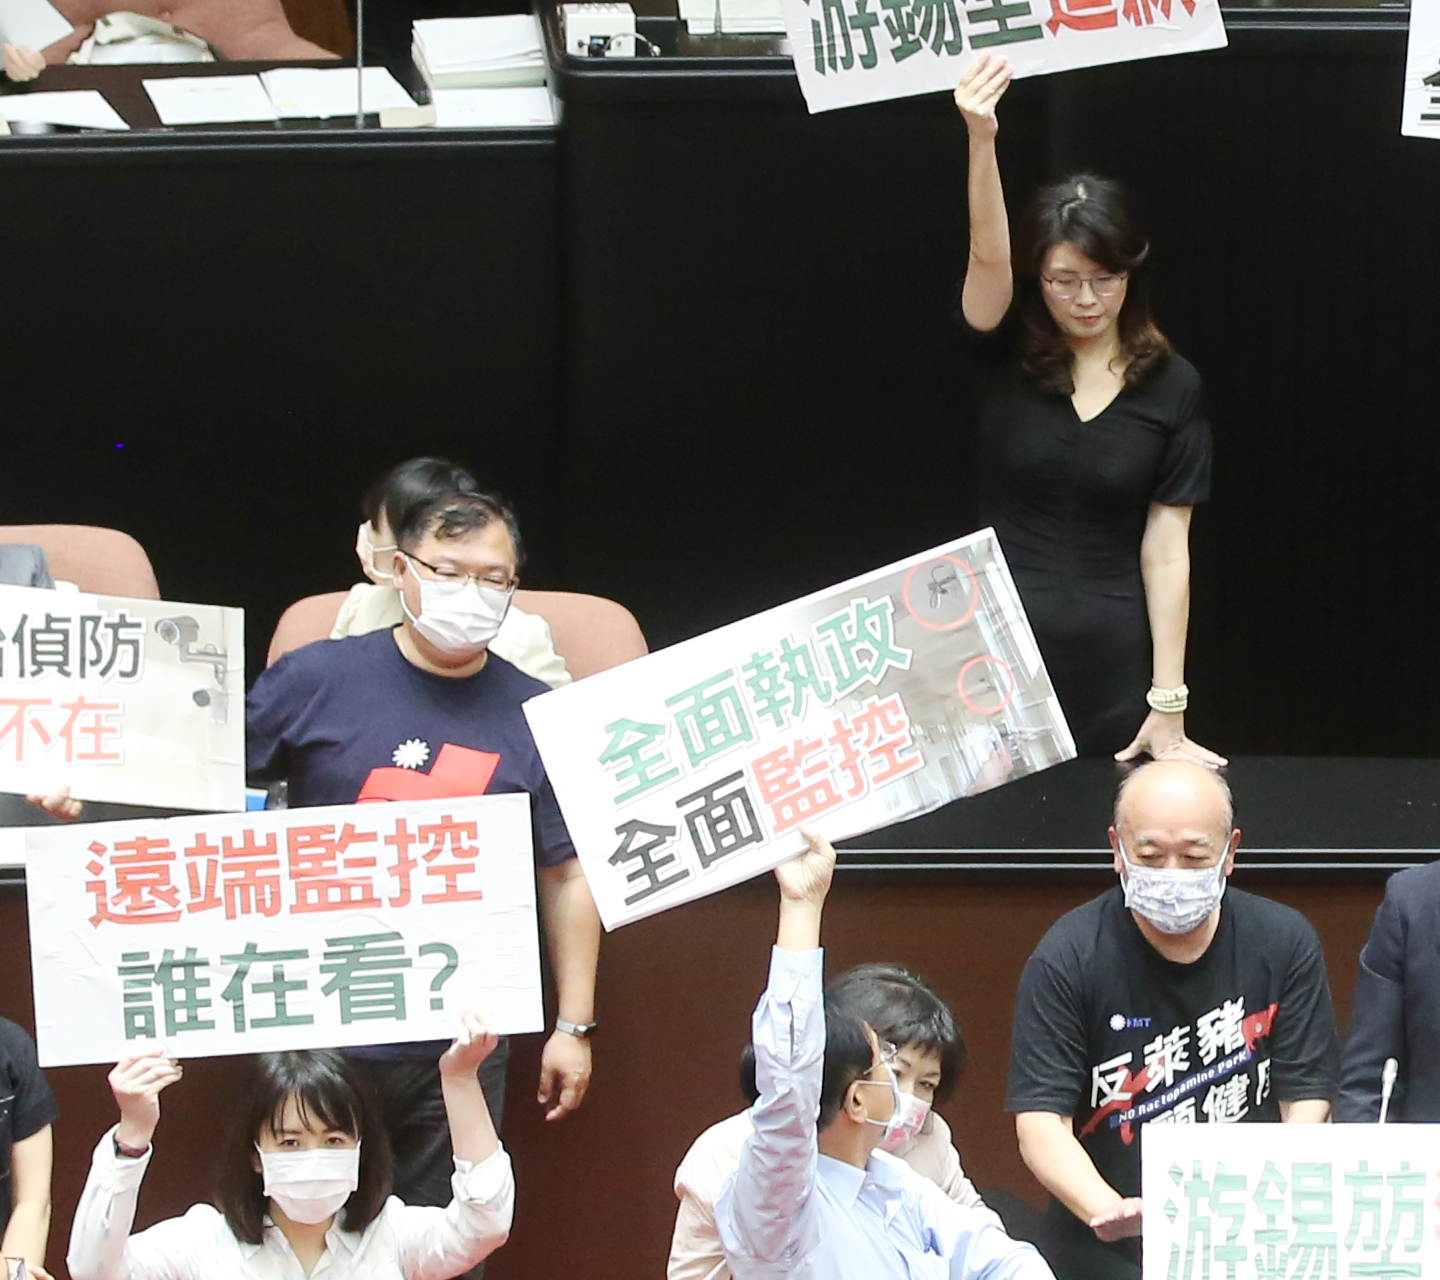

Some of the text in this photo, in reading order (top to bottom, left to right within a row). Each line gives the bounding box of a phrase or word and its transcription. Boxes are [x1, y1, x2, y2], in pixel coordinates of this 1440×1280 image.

[598, 597, 913, 807] 全面執政
[607, 700, 921, 906] 全面監控
[85, 814, 486, 929] 遠端監控
[119, 928, 461, 1040] 誰在看?
[1091, 996, 1247, 1109] 反萊豬
[1218, 1051, 1247, 1077] Pork
